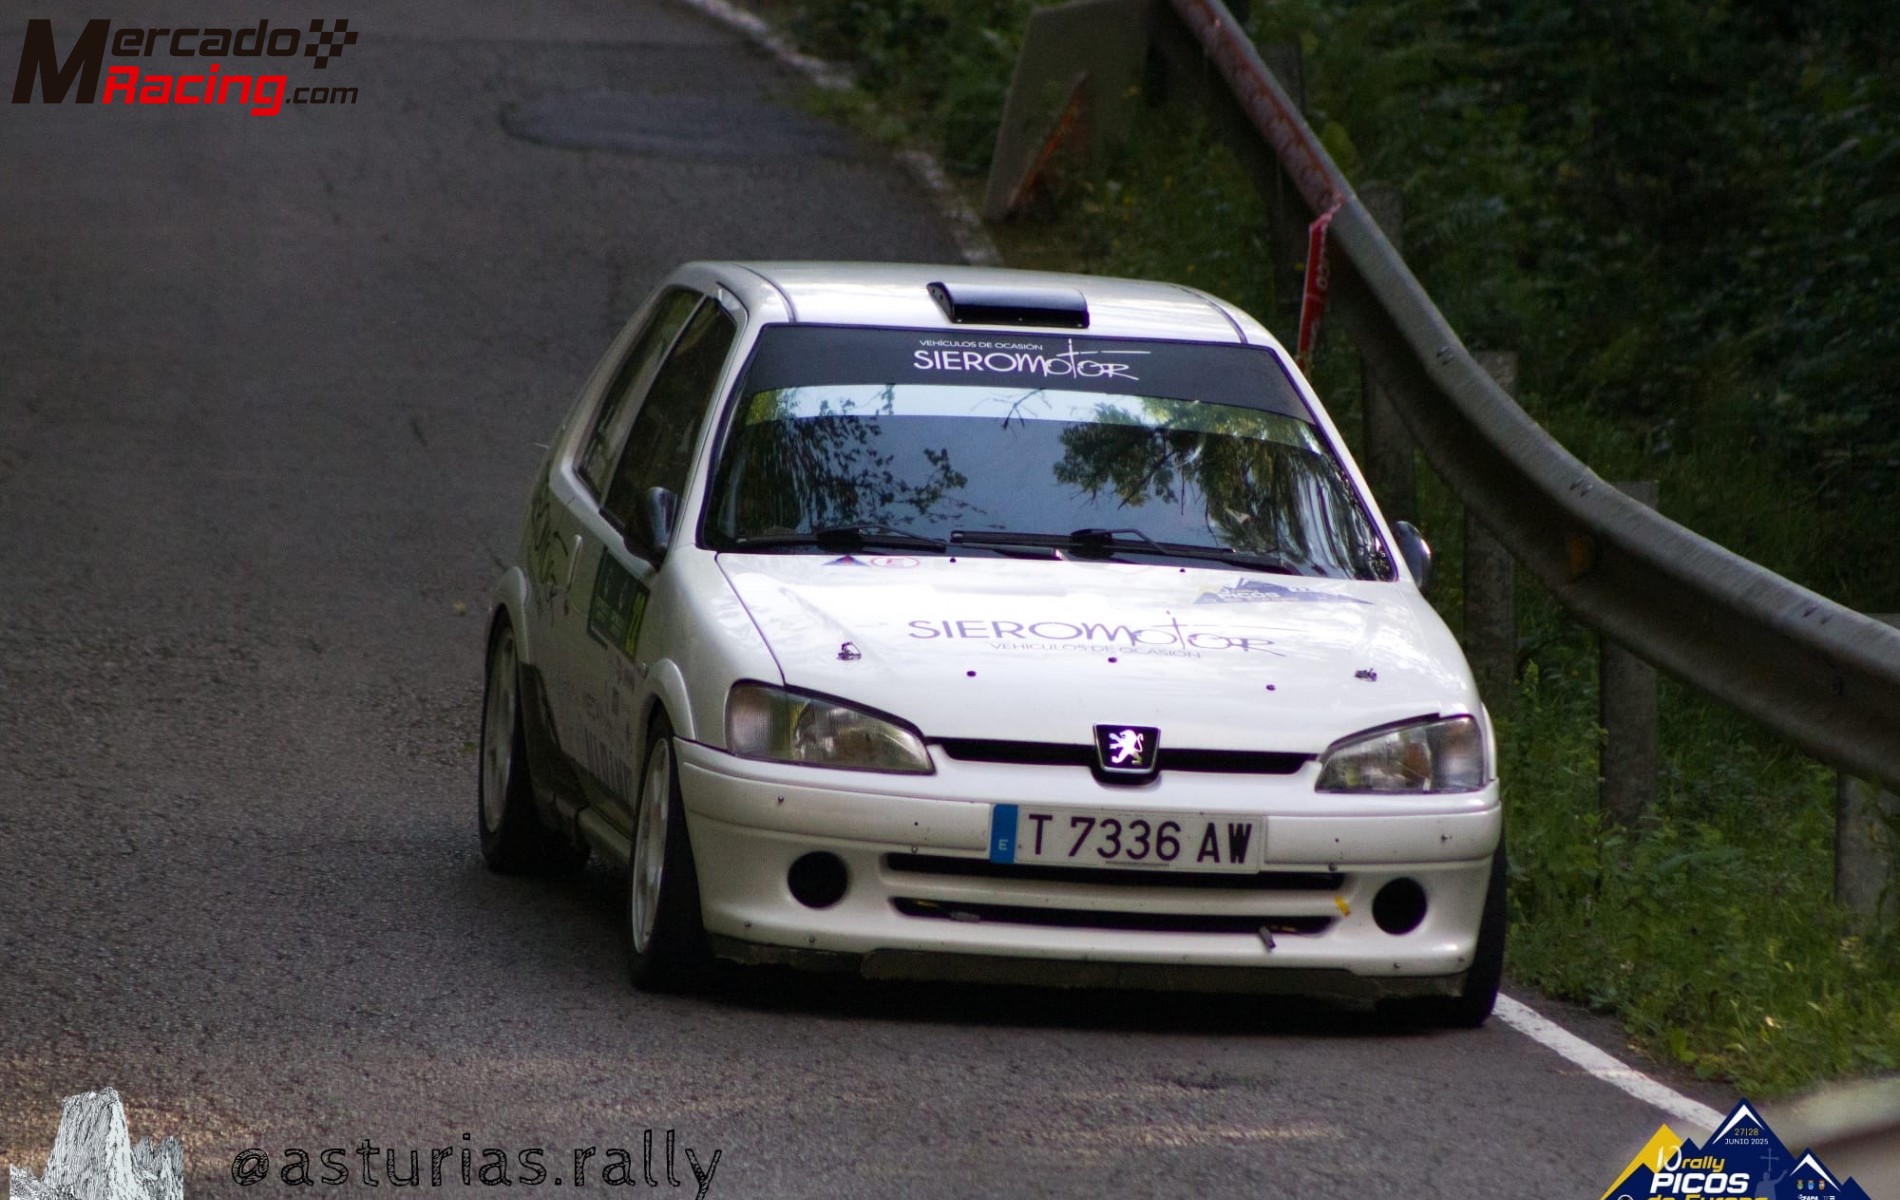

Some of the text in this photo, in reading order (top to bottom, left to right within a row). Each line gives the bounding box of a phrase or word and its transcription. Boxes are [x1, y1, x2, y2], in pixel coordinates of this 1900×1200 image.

[978, 341, 993, 349] DE
[1028, 813, 1253, 864] T 7336 AW
[998, 839, 1008, 850] E
